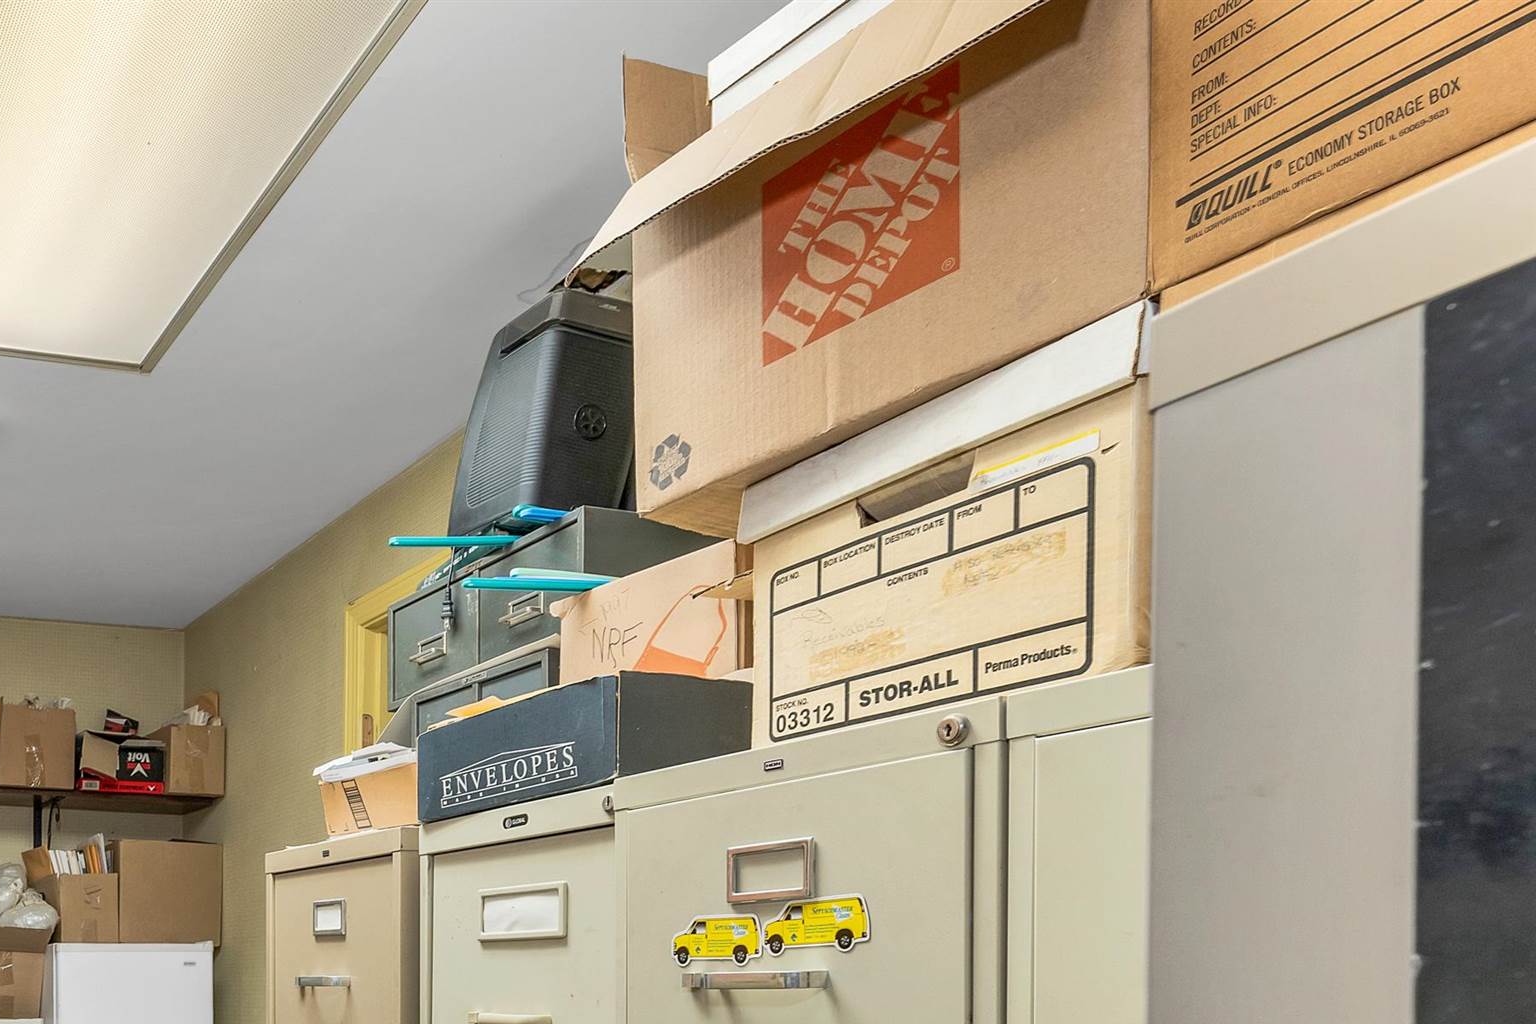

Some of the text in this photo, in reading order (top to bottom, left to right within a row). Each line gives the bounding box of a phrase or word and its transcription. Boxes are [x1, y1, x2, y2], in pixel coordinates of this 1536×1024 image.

[1192, 19, 1257, 69] CONTENTS:
[1191, 72, 1229, 104] FROM:
[1190, 94, 1277, 153] SPECIAL INFO:
[1191, 100, 1221, 129] DEPT:
[1288, 130, 1356, 176] ECONOMY
[1358, 94, 1425, 140] STORAGE
[1429, 77, 1461, 105] BOX
[762, 82, 960, 350] HOME
[777, 158, 858, 254] THE
[832, 147, 961, 322] DEPOT
[1022, 485, 1037, 496] TO
[956, 504, 983, 521] FROM
[885, 517, 945, 546] DESTROY DATE
[823, 543, 876, 568] BOX LOCATION
[776, 573, 791, 586] BOX
[886, 567, 929, 588] CONTENTS
[985, 657, 1019, 674] Perma
[859, 669, 960, 708] STOR-ALL
[776, 701, 797, 713] STOCK
[776, 702, 835, 734] 03312
[128, 752, 151, 764] Voit
[441, 743, 575, 799] ENVELOPES
